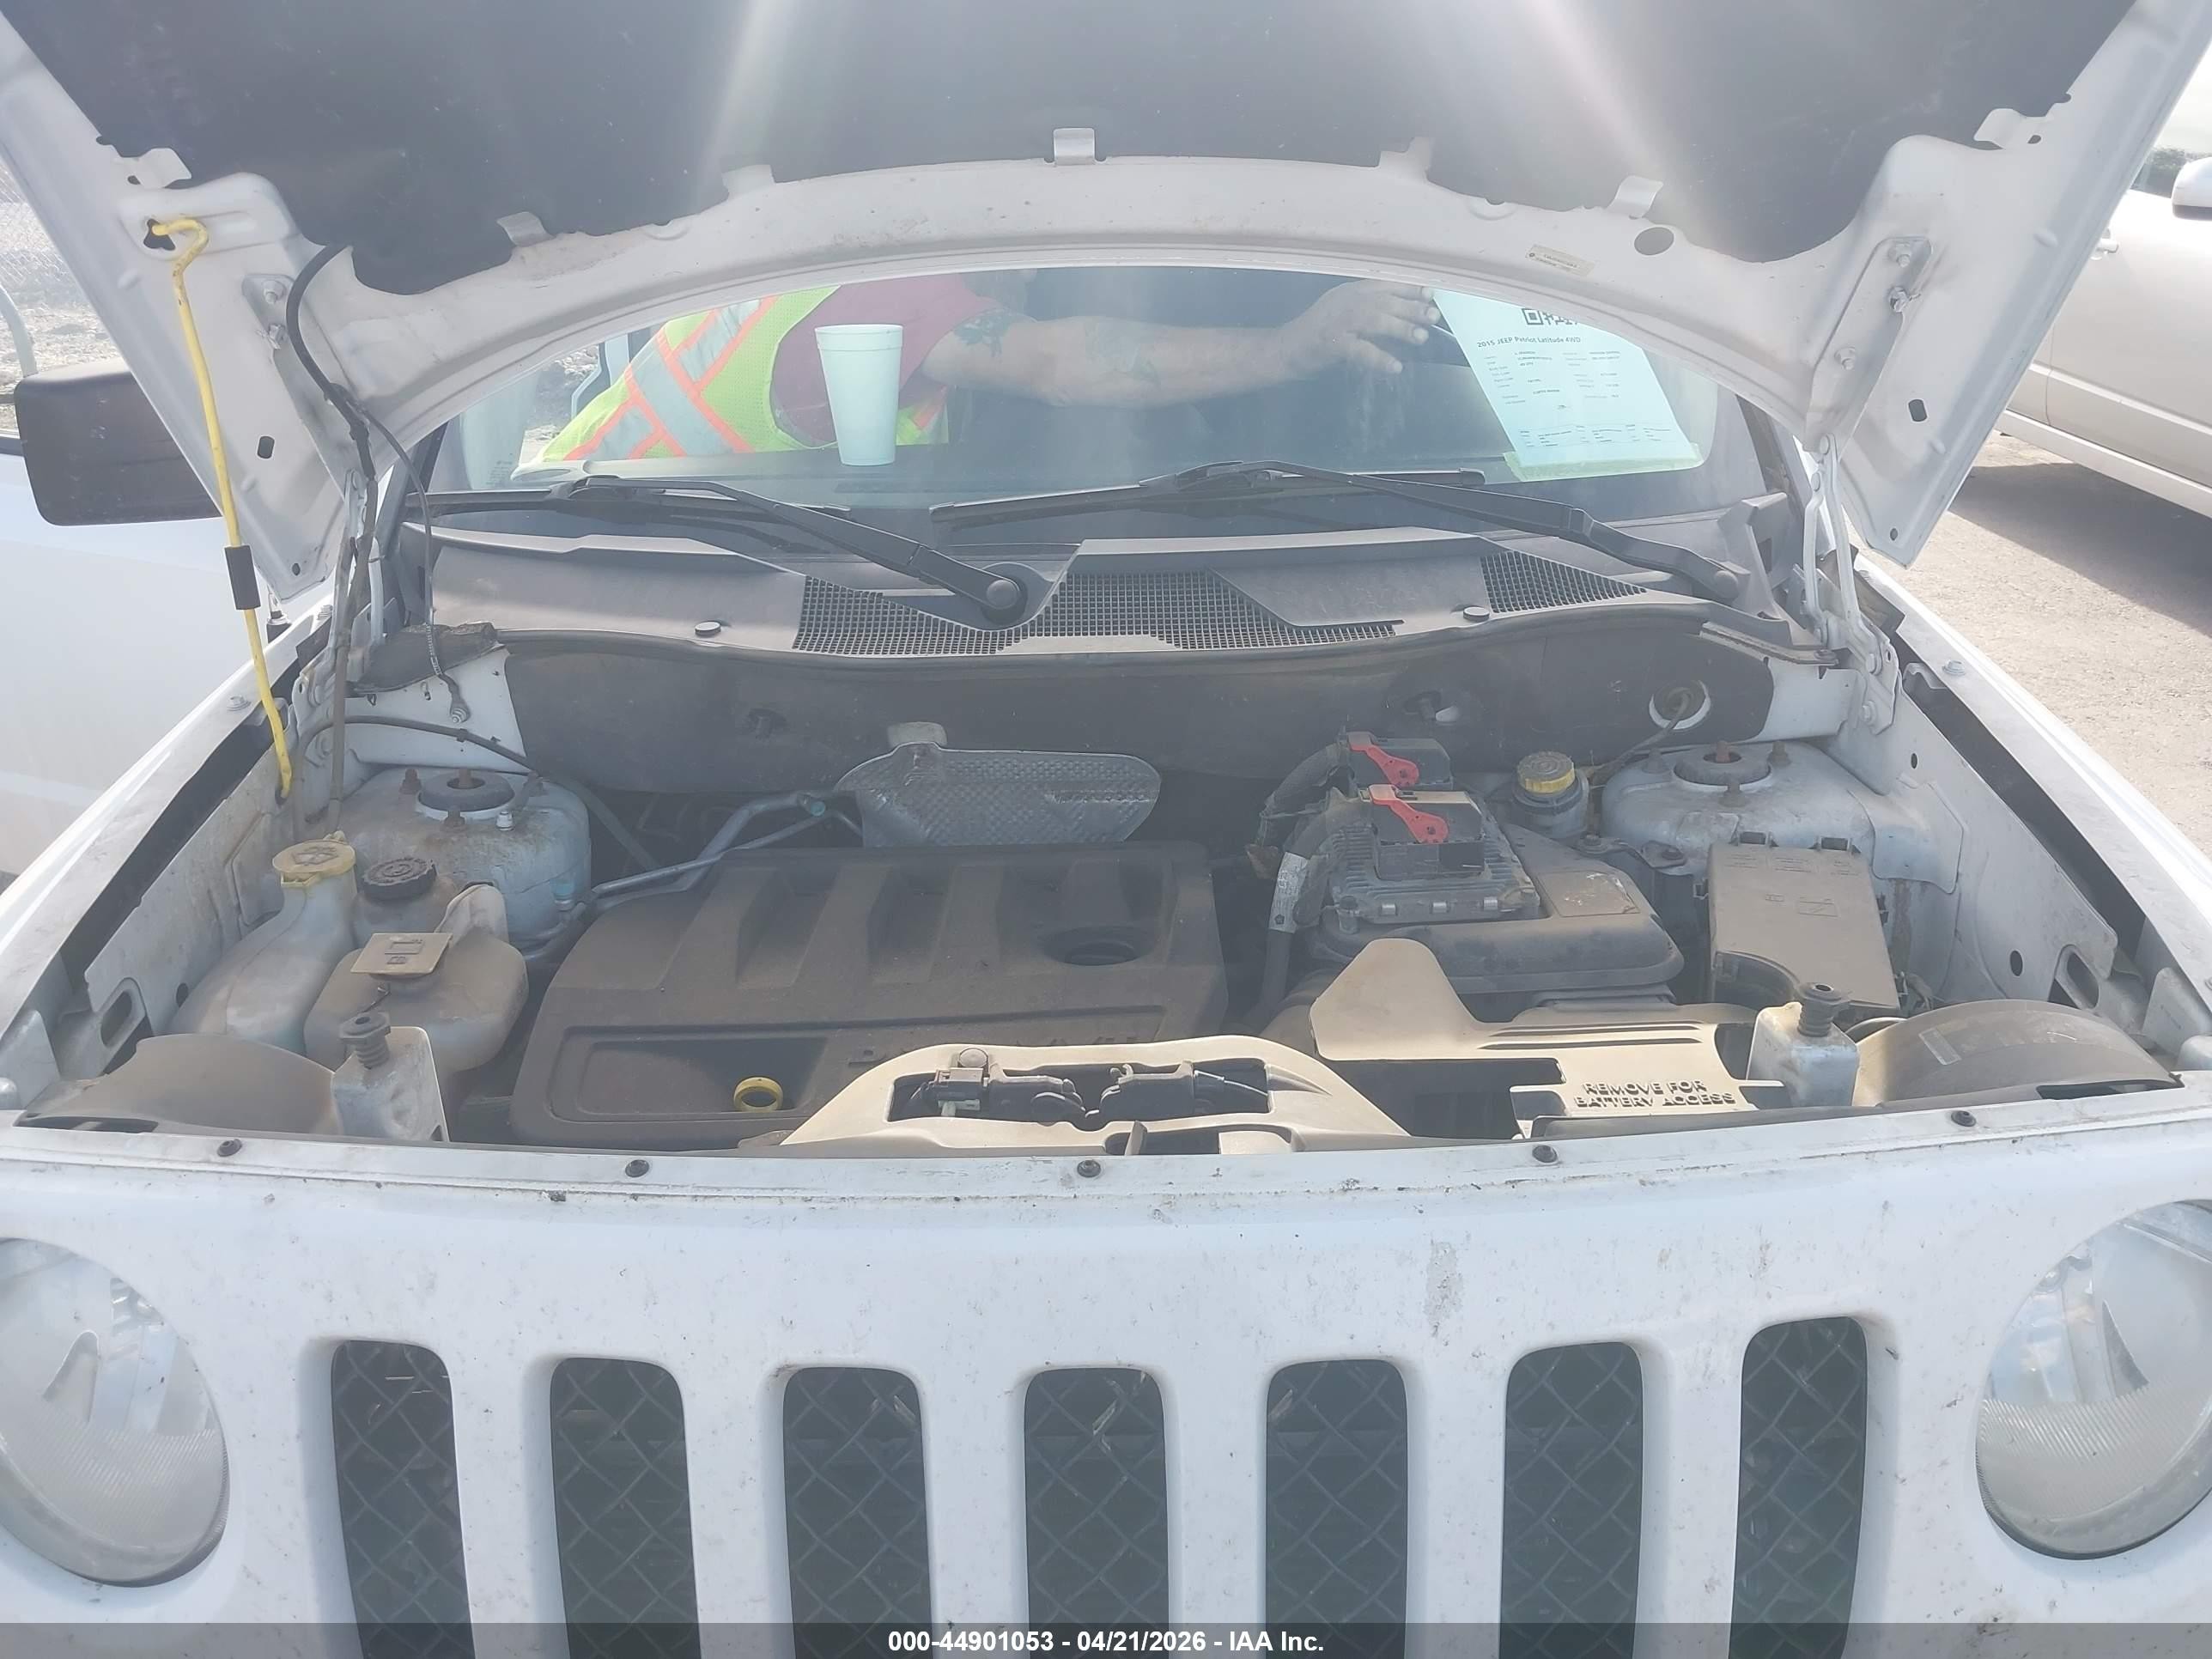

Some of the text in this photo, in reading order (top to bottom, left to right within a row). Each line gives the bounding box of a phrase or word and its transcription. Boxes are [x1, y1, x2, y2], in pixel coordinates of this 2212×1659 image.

[1497, 337, 1513, 345] JEEP
[1583, 1079, 1707, 1095] REMOVE FOR
[1574, 1092, 1735, 1108] BATTERY ACCESS
